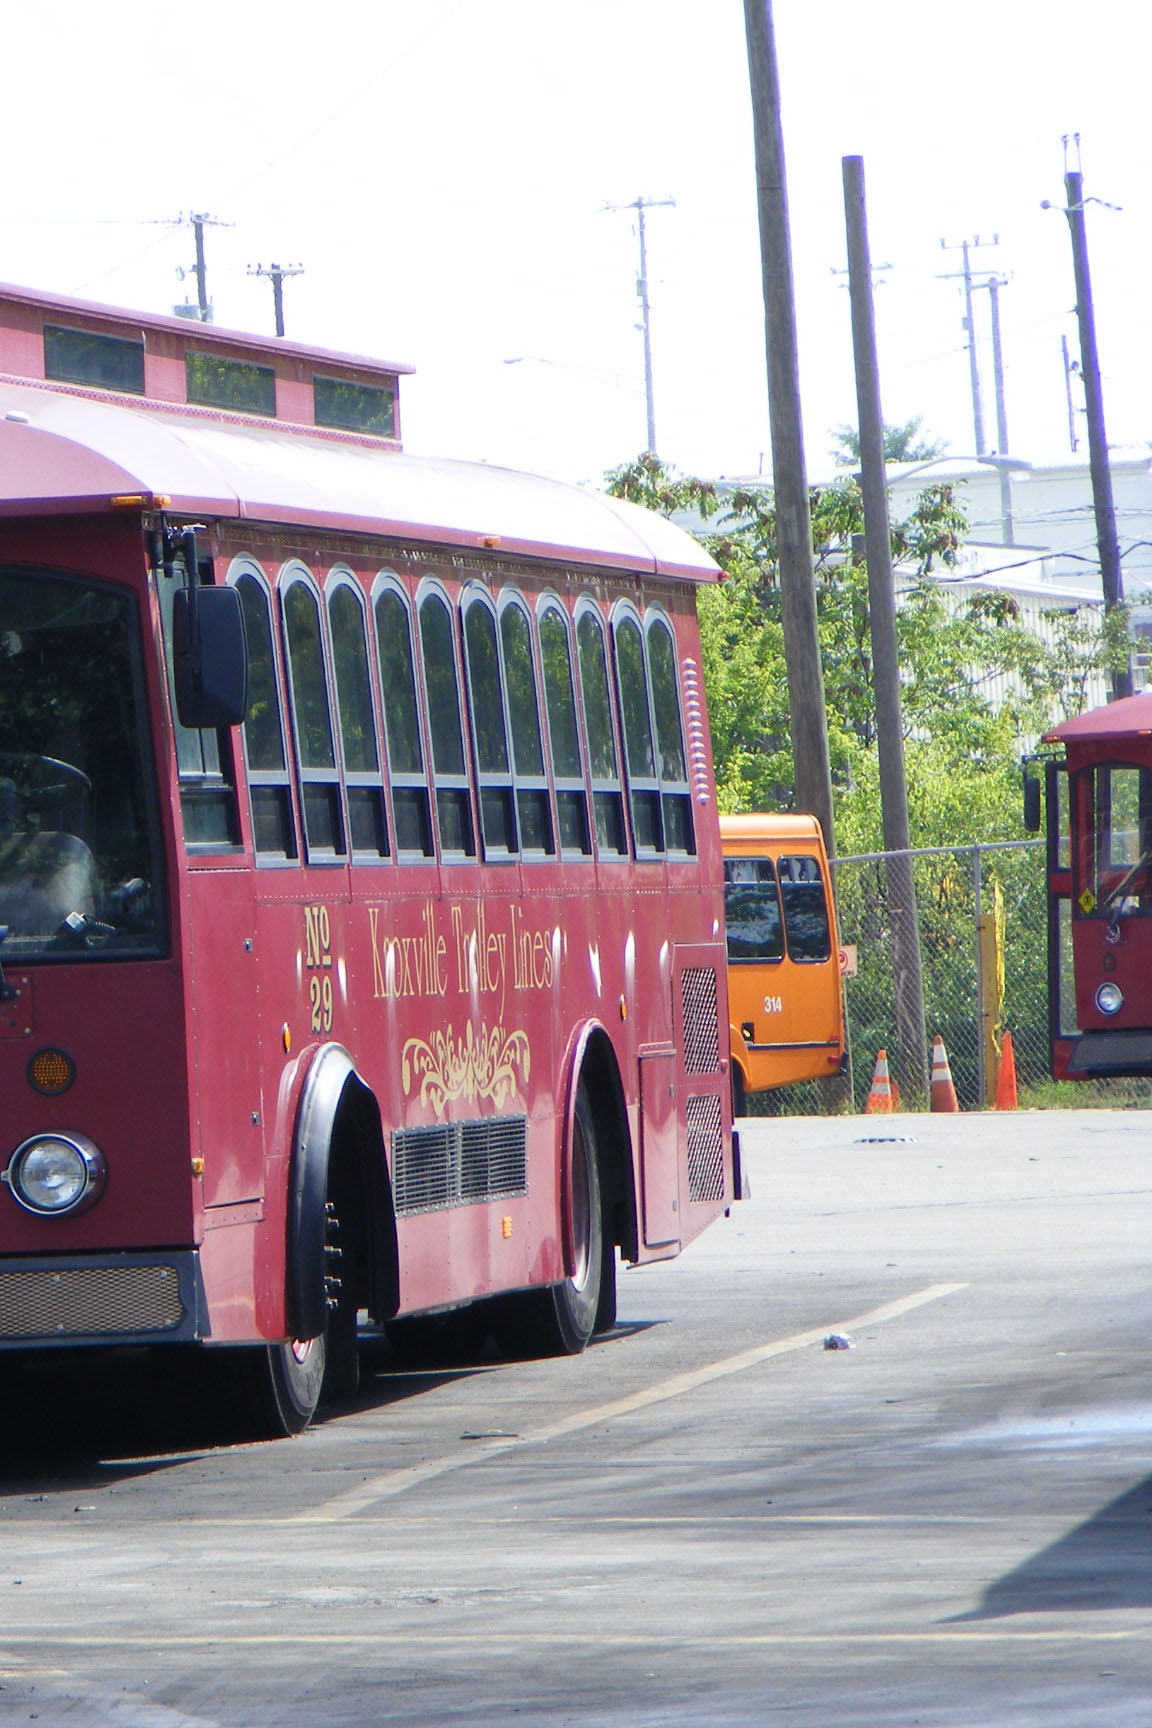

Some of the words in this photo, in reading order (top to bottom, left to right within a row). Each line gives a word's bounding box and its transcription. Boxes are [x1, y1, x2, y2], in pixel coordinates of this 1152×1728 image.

[368, 900, 448, 998] Knoxville
[451, 899, 506, 1024] Trolley
[510, 905, 552, 989] Lines
[310, 975, 333, 1034] 29
[764, 996, 782, 1013] 314
